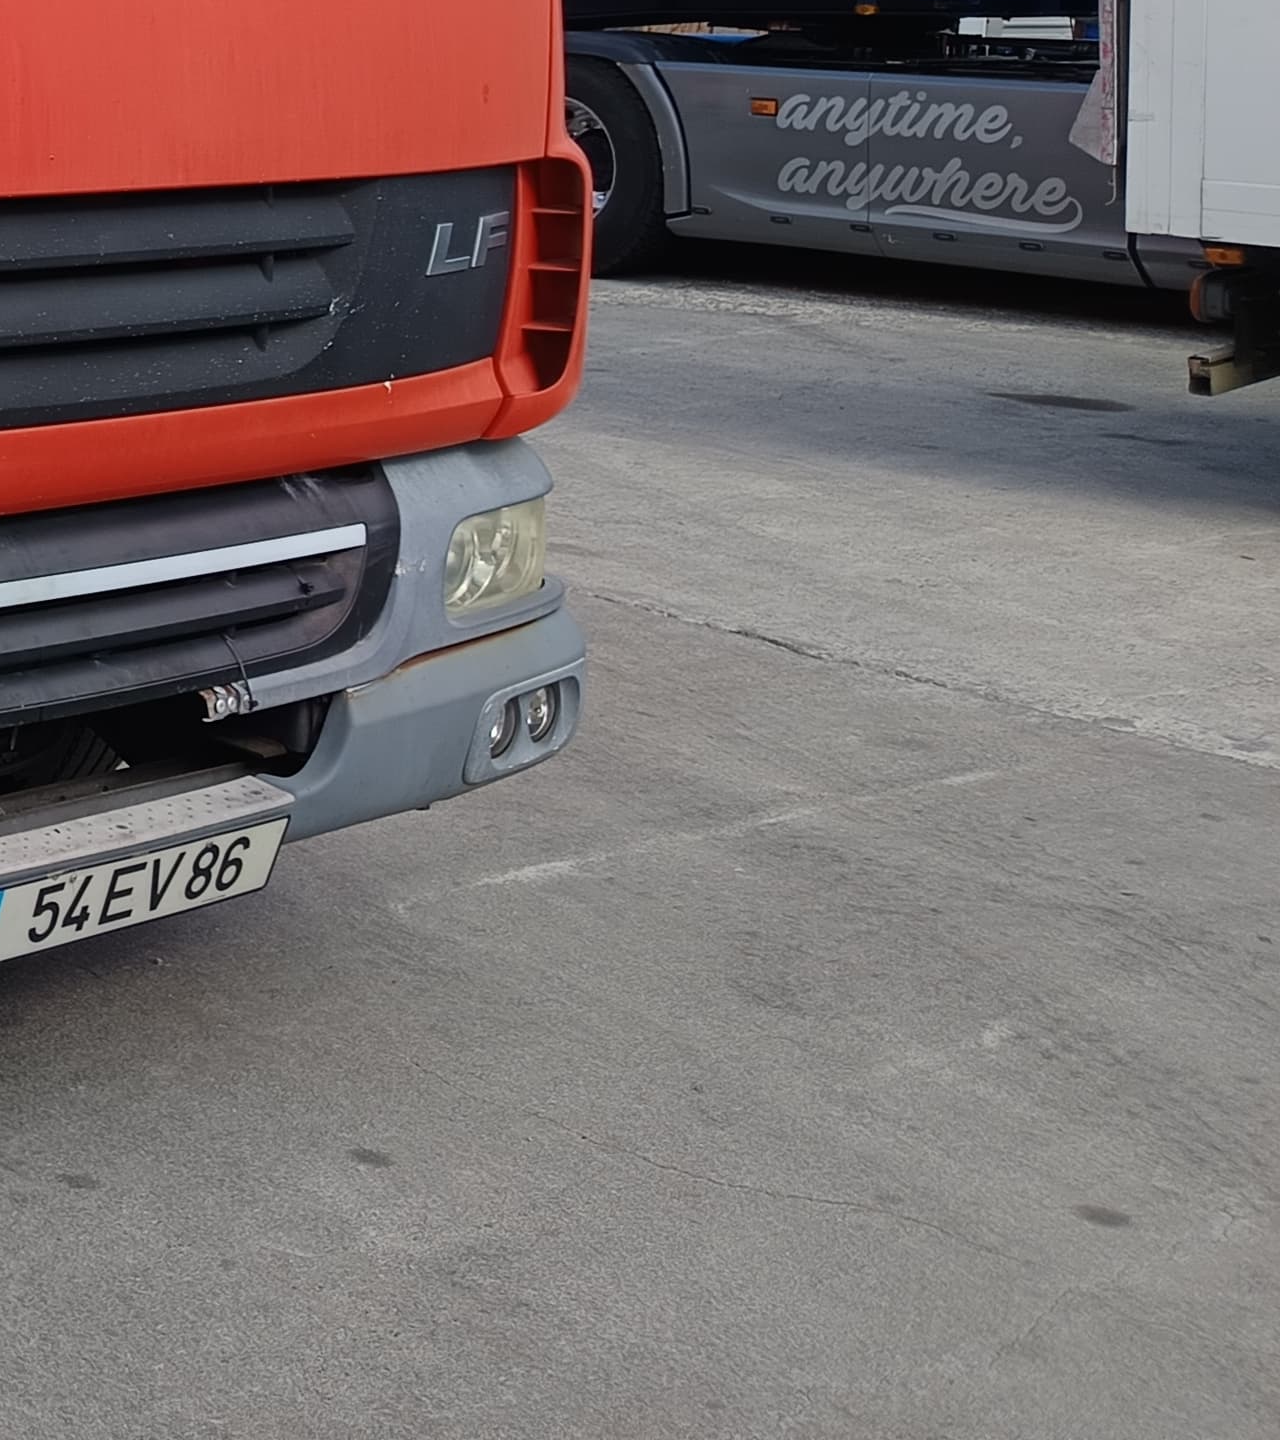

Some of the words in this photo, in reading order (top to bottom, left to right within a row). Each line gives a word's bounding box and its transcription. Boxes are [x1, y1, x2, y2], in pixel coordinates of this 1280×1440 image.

[776, 90, 1024, 149] anytime,
[776, 156, 1083, 234] anywhere
[425, 211, 510, 277] LF
